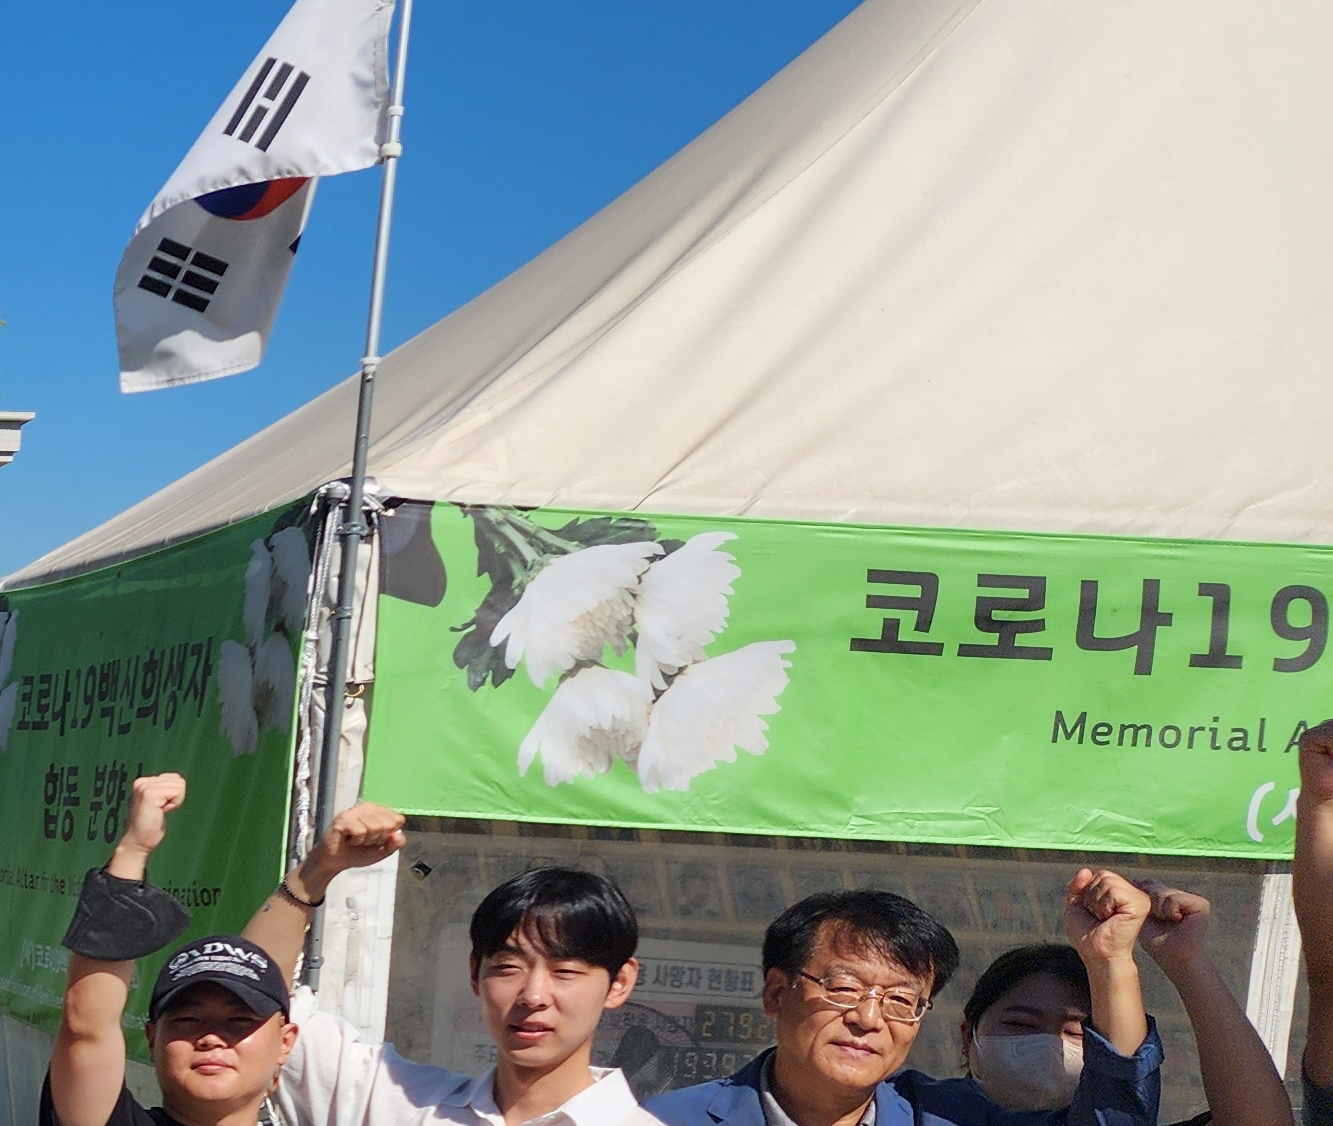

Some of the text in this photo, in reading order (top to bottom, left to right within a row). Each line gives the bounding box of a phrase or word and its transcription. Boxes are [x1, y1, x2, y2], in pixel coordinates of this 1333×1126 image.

[849, 568, 1330, 676] 코로나19
[17, 636, 213, 737] 코로나19백신희생자
[1051, 710, 1267, 754] Memorial
[44, 760, 144, 844] 합동 분향
